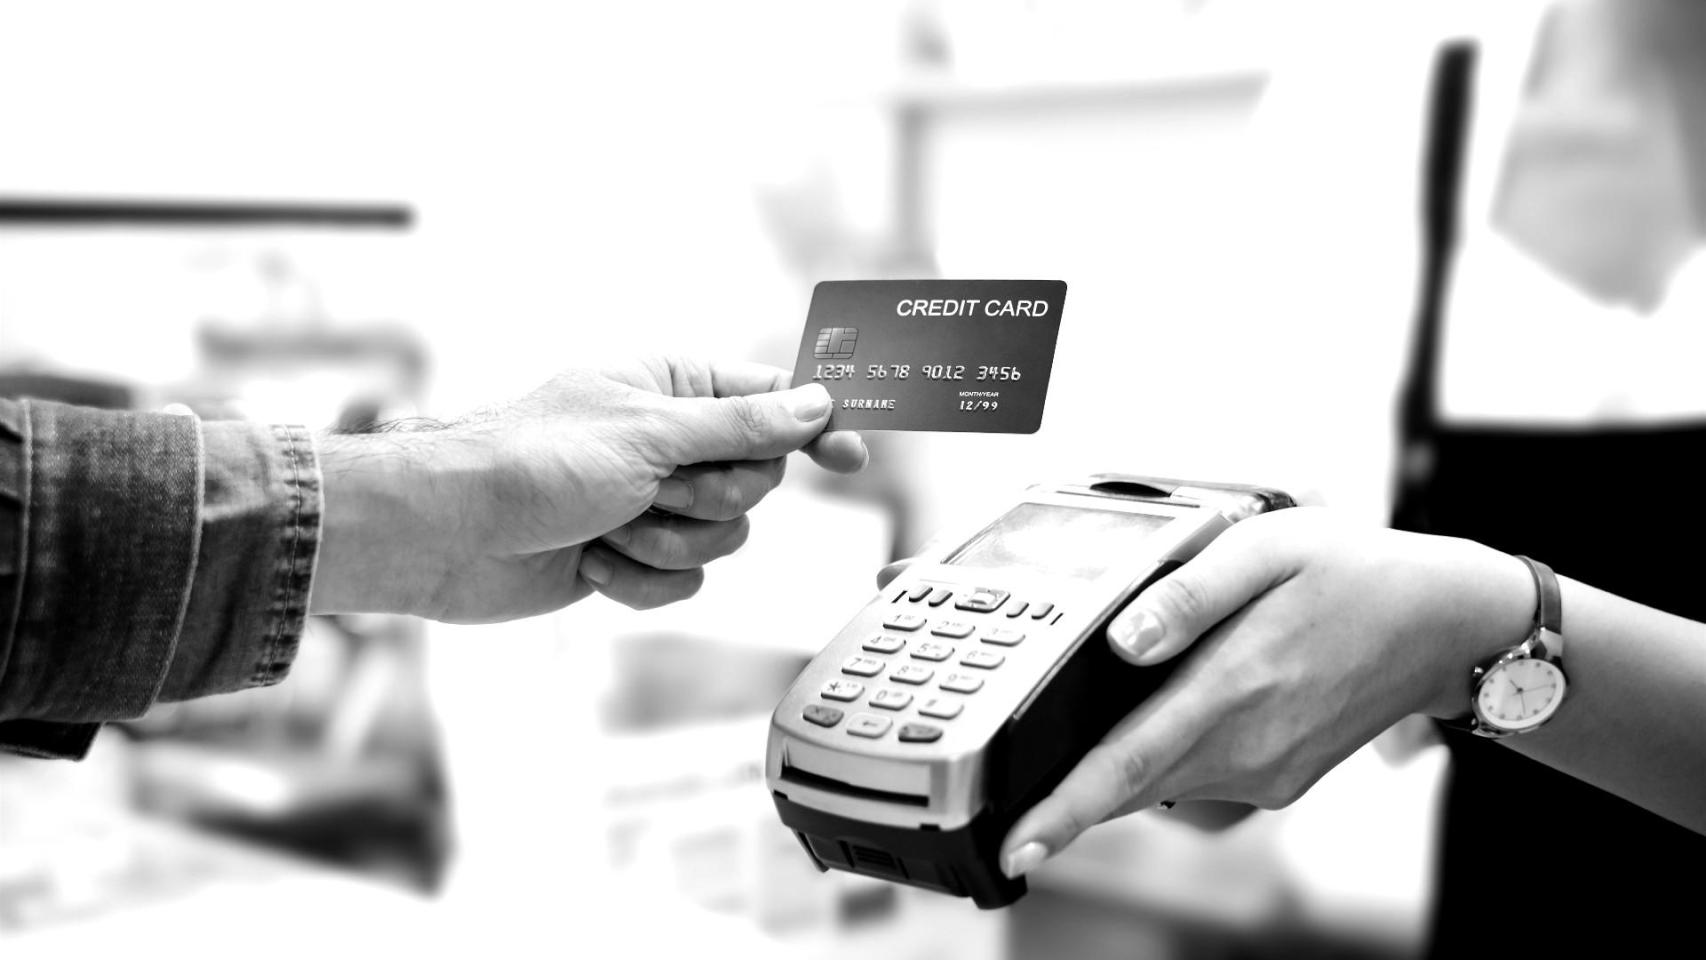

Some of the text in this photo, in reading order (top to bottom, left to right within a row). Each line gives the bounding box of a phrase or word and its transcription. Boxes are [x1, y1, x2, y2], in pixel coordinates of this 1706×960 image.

[896, 299, 1049, 317] CREDIT CARD
[812, 364, 1022, 381] 1234 5678 9012 3456
[842, 398, 896, 410] SURNAME
[959, 400, 999, 411] 12/99
[936, 620, 950, 630] 2
[869, 635, 882, 645] 4
[916, 643, 930, 653] 5
[850, 657, 862, 667] 7
[875, 689, 888, 700] 0
